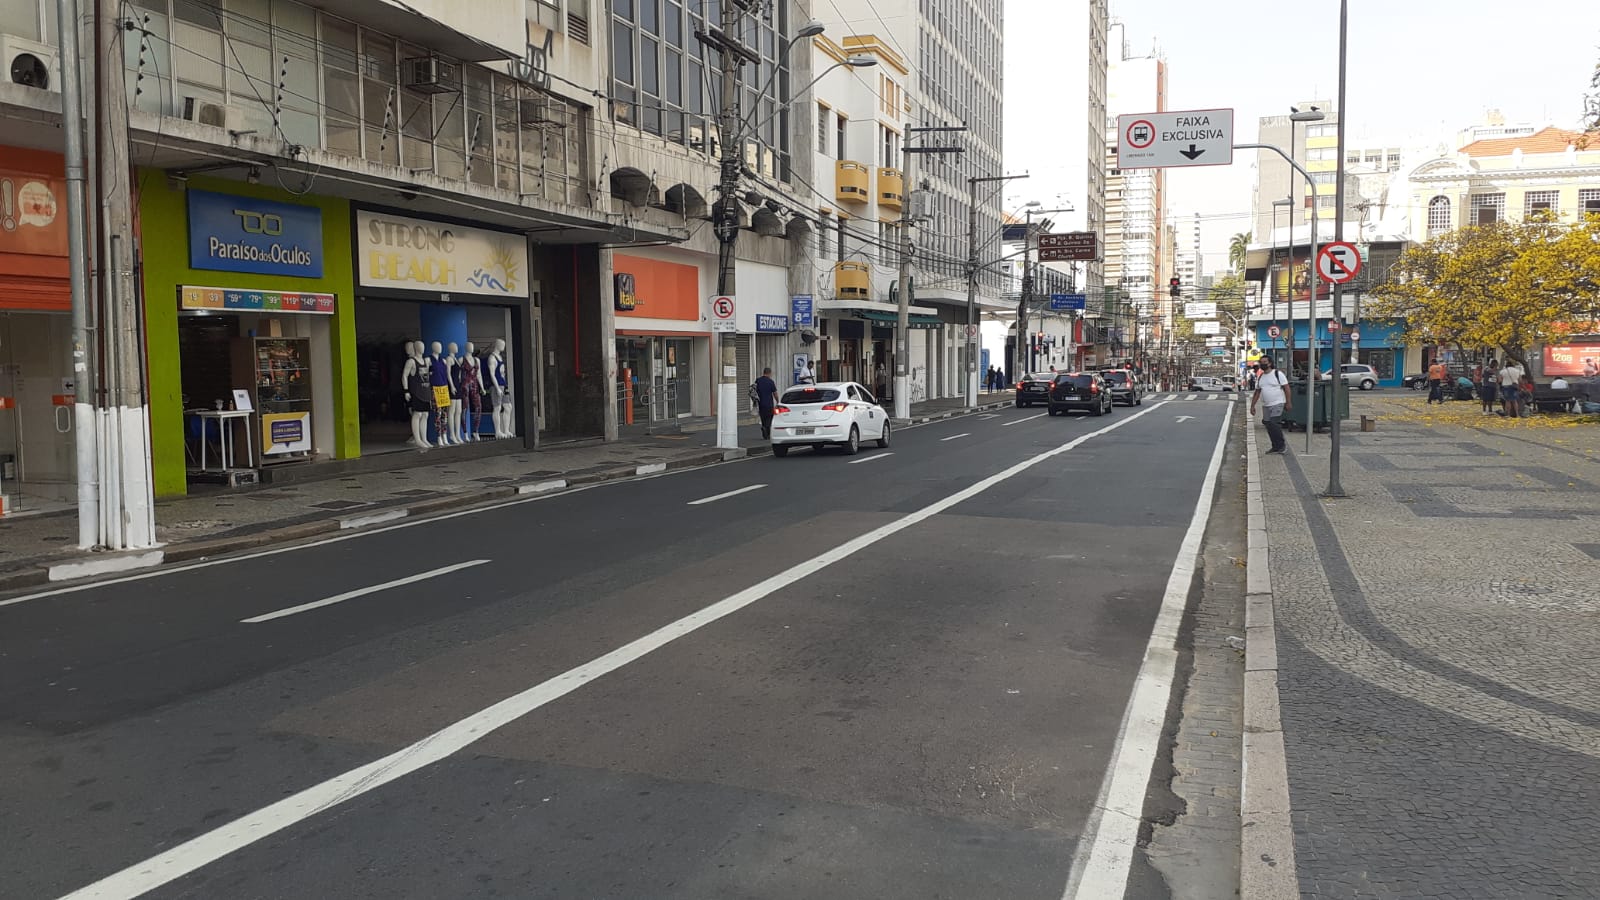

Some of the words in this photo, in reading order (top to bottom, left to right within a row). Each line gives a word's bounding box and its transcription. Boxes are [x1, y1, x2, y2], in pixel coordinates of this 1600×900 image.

[1176, 116, 1210, 127] FAIXA
[1162, 129, 1224, 141] EXCLUSIVA
[369, 219, 456, 254] STRONG
[210, 236, 259, 261] Paraíso
[259, 249, 272, 262] dos
[369, 251, 457, 286] BEACH
[760, 315, 787, 330] ESTACIONE
[794, 312, 802, 322] 8
